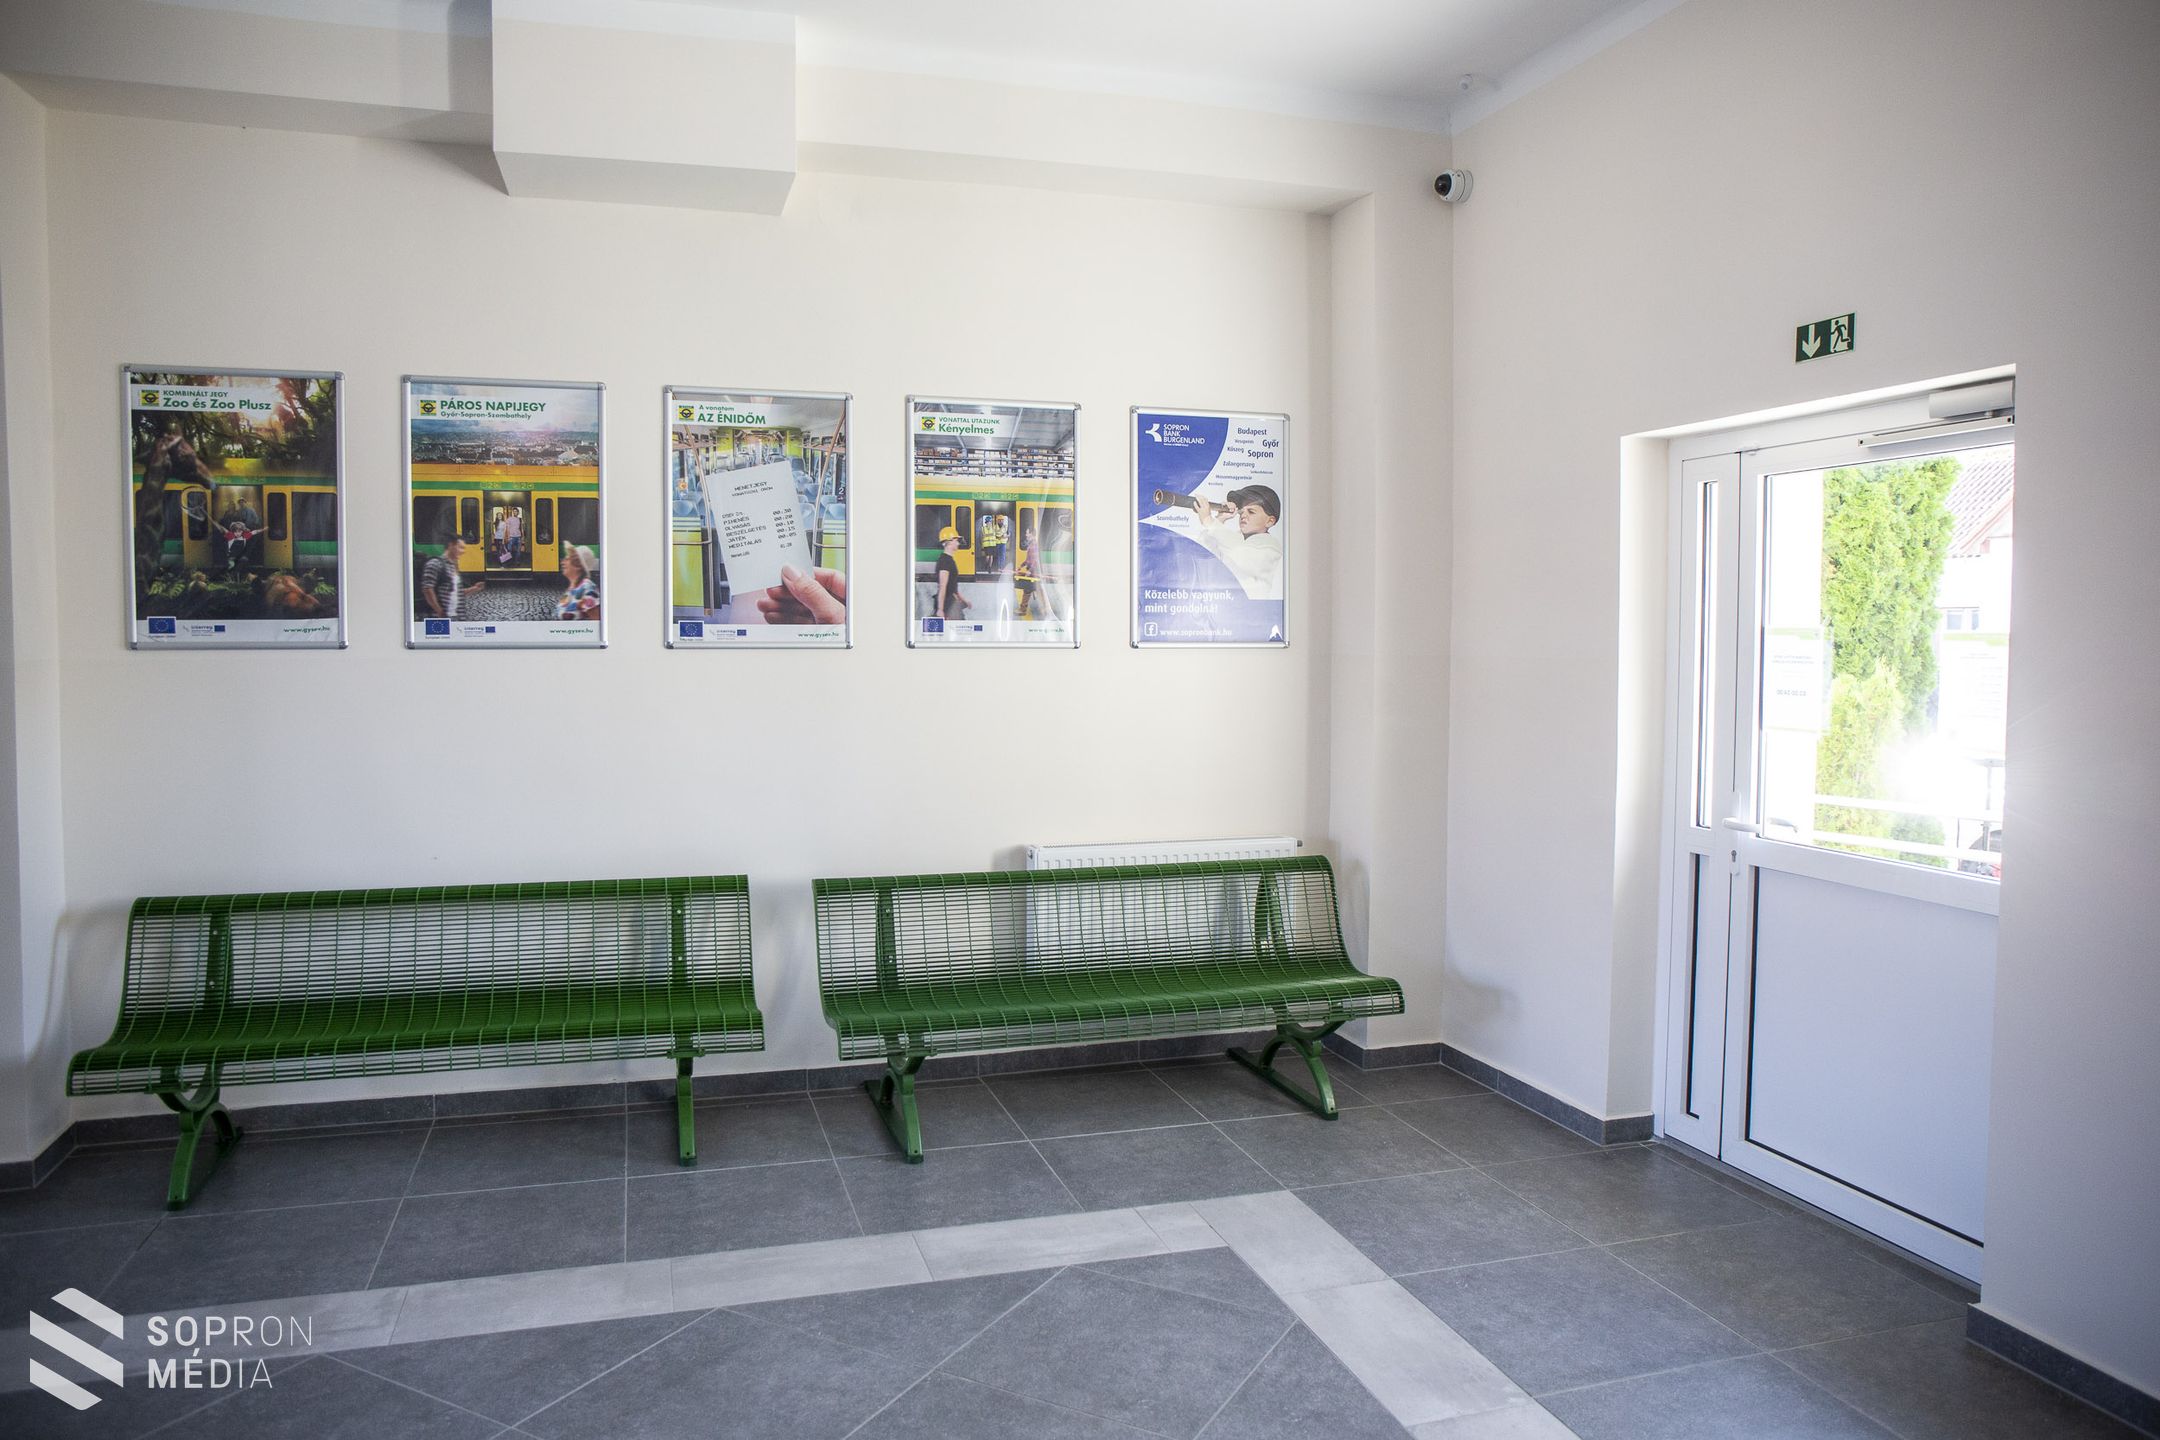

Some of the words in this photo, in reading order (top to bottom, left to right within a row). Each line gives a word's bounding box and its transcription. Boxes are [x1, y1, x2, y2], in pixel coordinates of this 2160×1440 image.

[163, 389, 208, 398] KOMBINÁLT
[163, 397, 189, 408] Zoo
[192, 398, 207, 409] és
[210, 399, 235, 410] Zoo
[239, 400, 272, 411] Plusz
[440, 398, 482, 410] PÁROS
[486, 402, 546, 412] NAPIJEGY
[698, 413, 714, 423] AZ
[938, 424, 995, 435] Kényelmes
[1237, 428, 1267, 436] Budapest
[1262, 439, 1279, 449] Győr
[1247, 450, 1274, 459] Sopron
[1144, 590, 1188, 600] Közelebb
[1191, 590, 1234, 601] vagyunk,
[1144, 604, 1170, 613] mint
